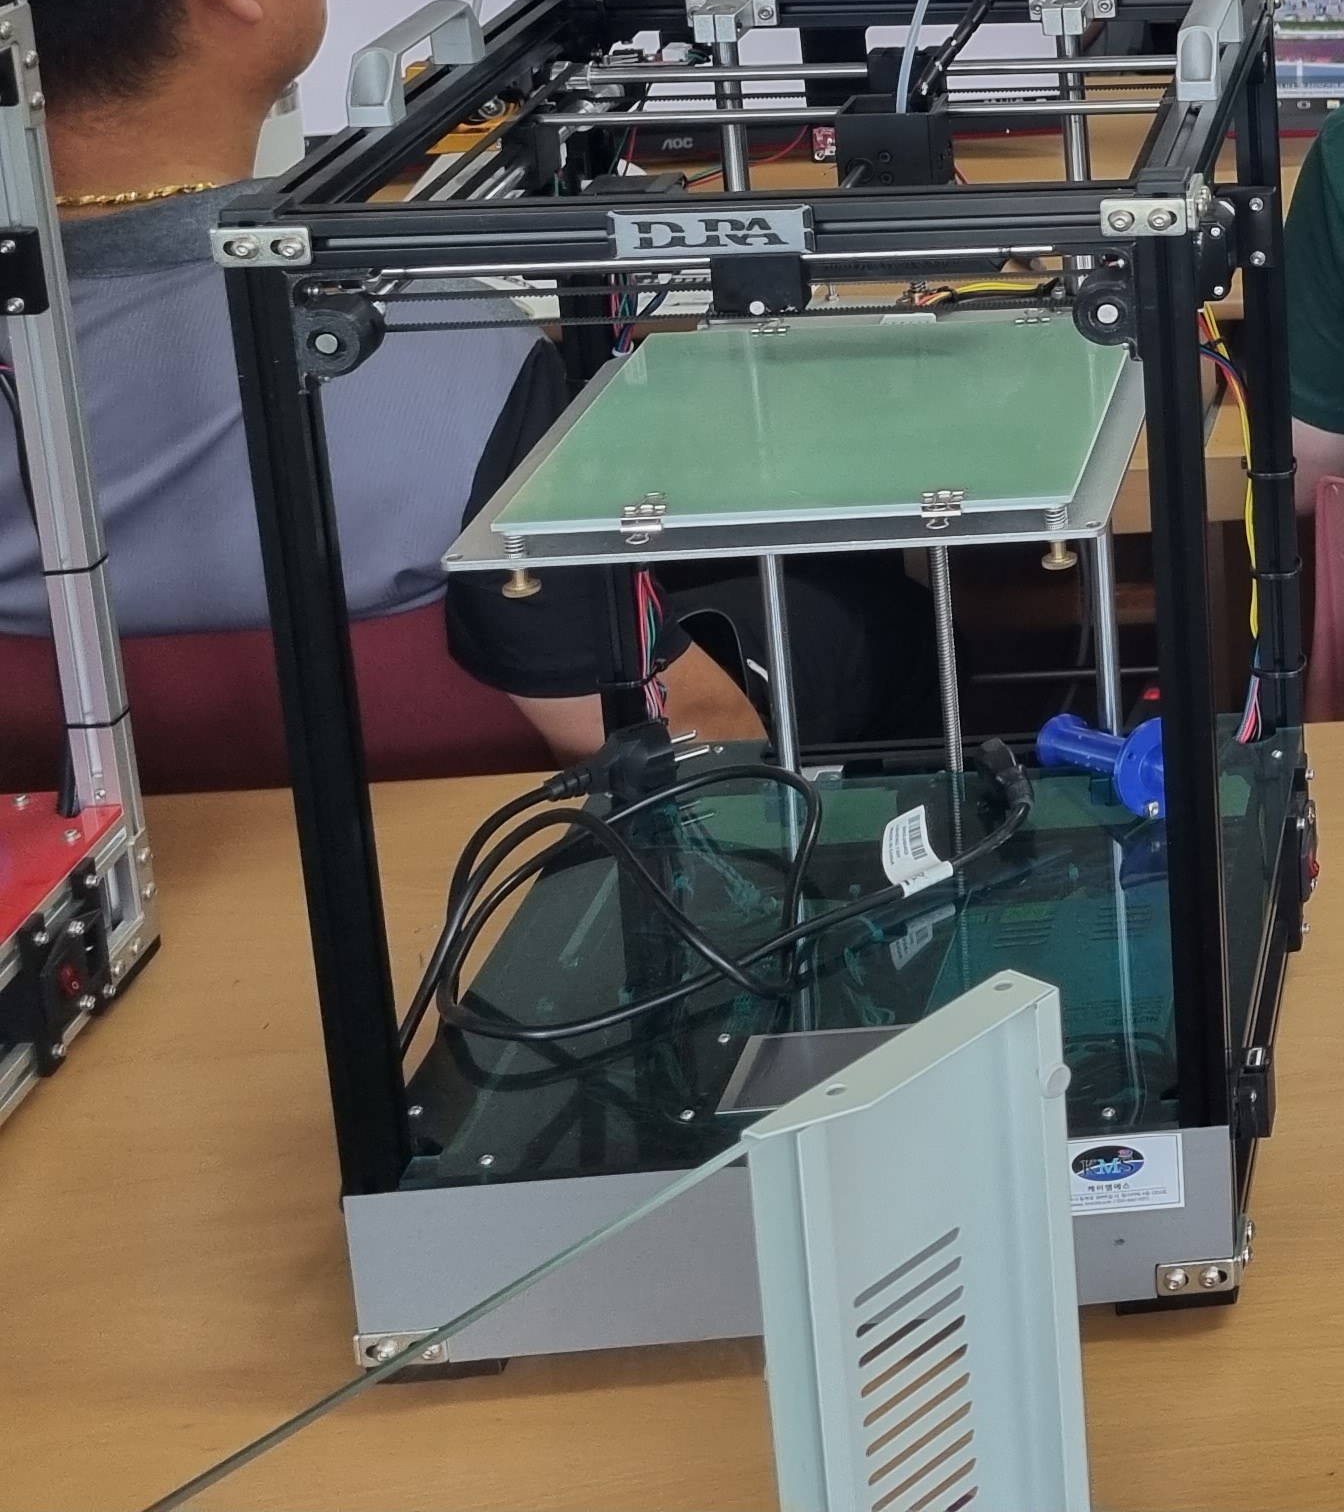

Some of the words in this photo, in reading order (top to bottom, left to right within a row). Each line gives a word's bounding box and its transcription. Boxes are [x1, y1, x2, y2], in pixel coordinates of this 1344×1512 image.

[661, 137, 694, 150] AOC
[631, 216, 789, 250] DURA
[1081, 1158, 1135, 1175] KMS
